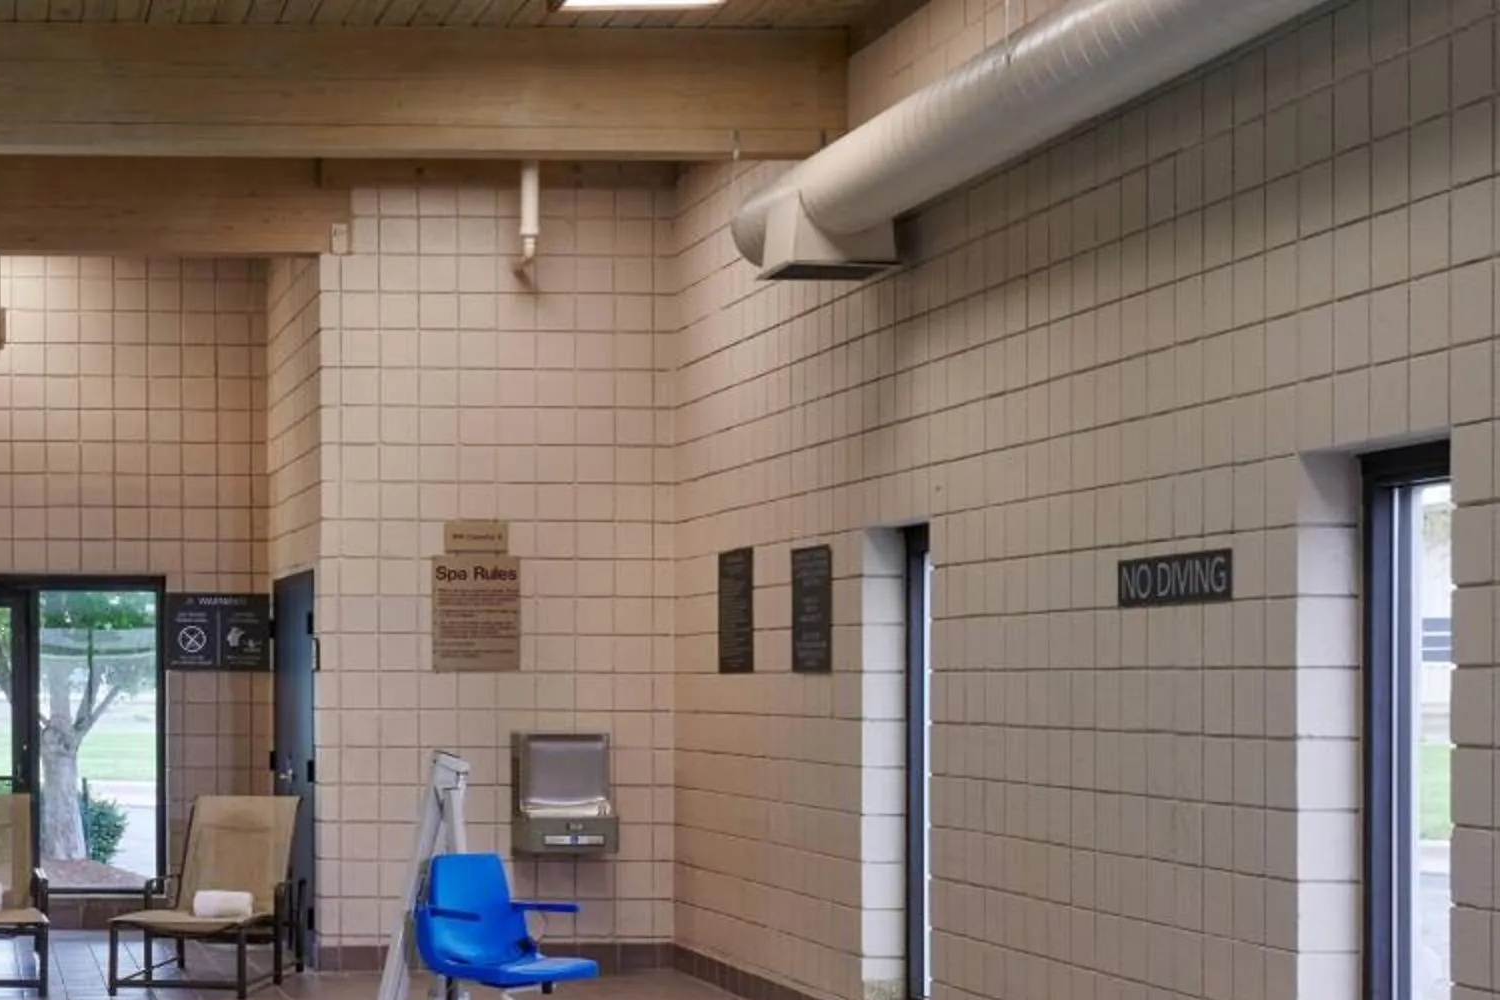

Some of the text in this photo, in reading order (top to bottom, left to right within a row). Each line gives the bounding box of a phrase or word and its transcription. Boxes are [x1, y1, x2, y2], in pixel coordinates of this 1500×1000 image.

[435, 564, 517, 583] Spa Rules
[1121, 556, 1227, 599] NO DIVING
